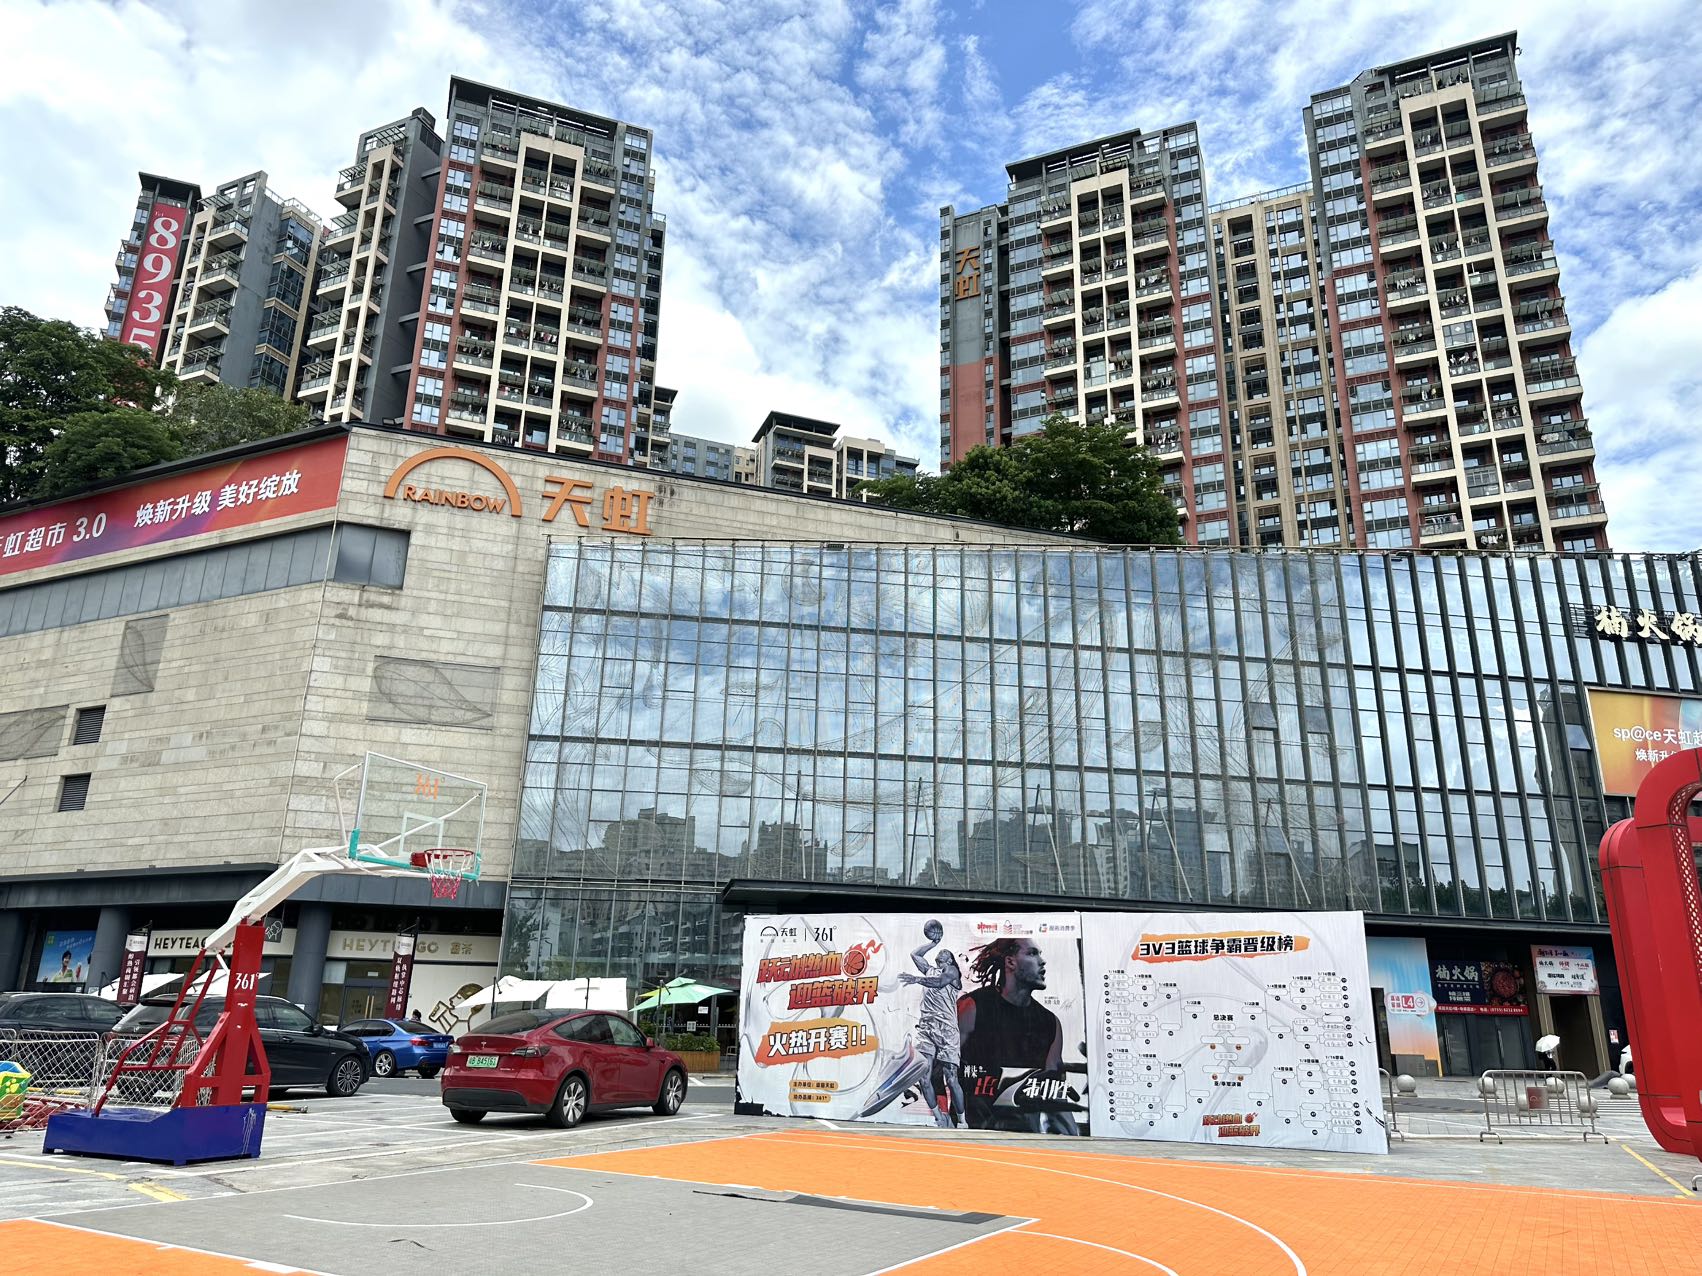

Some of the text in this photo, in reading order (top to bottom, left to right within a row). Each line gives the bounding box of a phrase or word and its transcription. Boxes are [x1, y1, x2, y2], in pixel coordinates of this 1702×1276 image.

[134, 470, 301, 527] 焕新升级 美好绽放
[403, 483, 505, 514] RAINBOW
[542, 475, 655, 535] 天虹
[0, 513, 107, 558] 虹超市 3.0
[781, 928, 797, 936] 天虹
[1139, 935, 1294, 957] 3V3篮球争霸晋级榜
[234, 972, 260, 990] 361°
[756, 951, 843, 983] 跃动燃血
[1436, 964, 1479, 980] 楠火锅
[787, 976, 878, 1010] 迎篮破界
[1402, 996, 1414, 1008] L4
